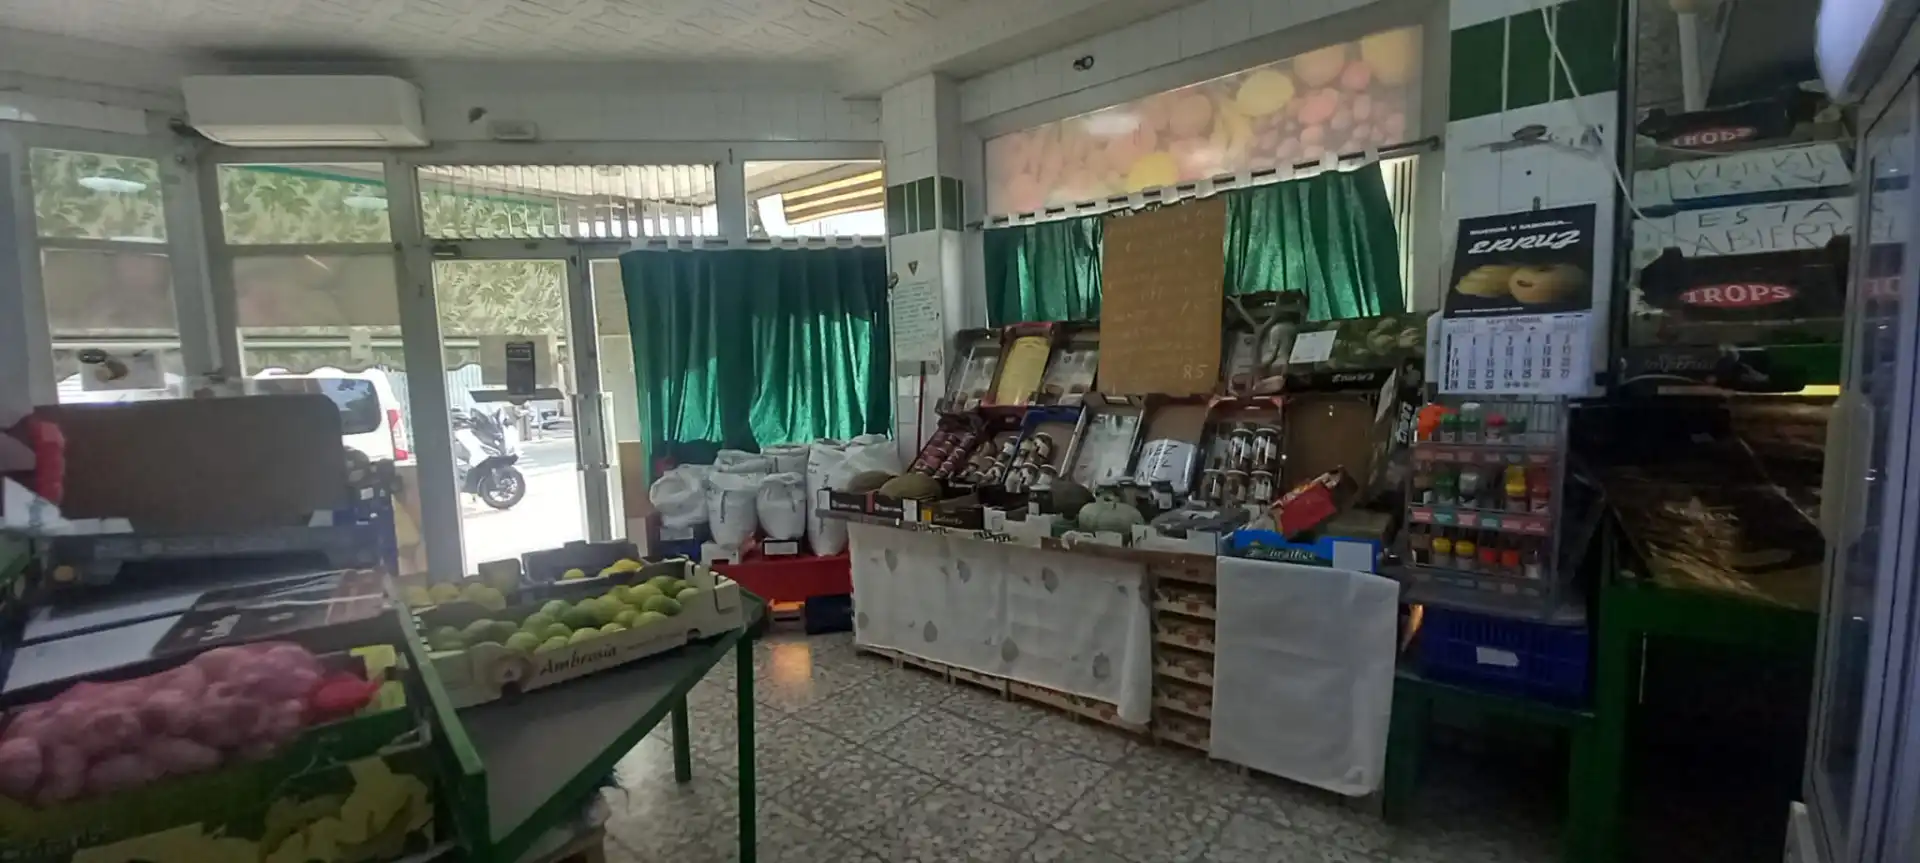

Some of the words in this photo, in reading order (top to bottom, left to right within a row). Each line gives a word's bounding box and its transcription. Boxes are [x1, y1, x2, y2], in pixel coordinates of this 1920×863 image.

[1698, 201, 1843, 228] ESTA
[1683, 284, 1792, 305] TROPS
[539, 643, 618, 676] Ambrosia
